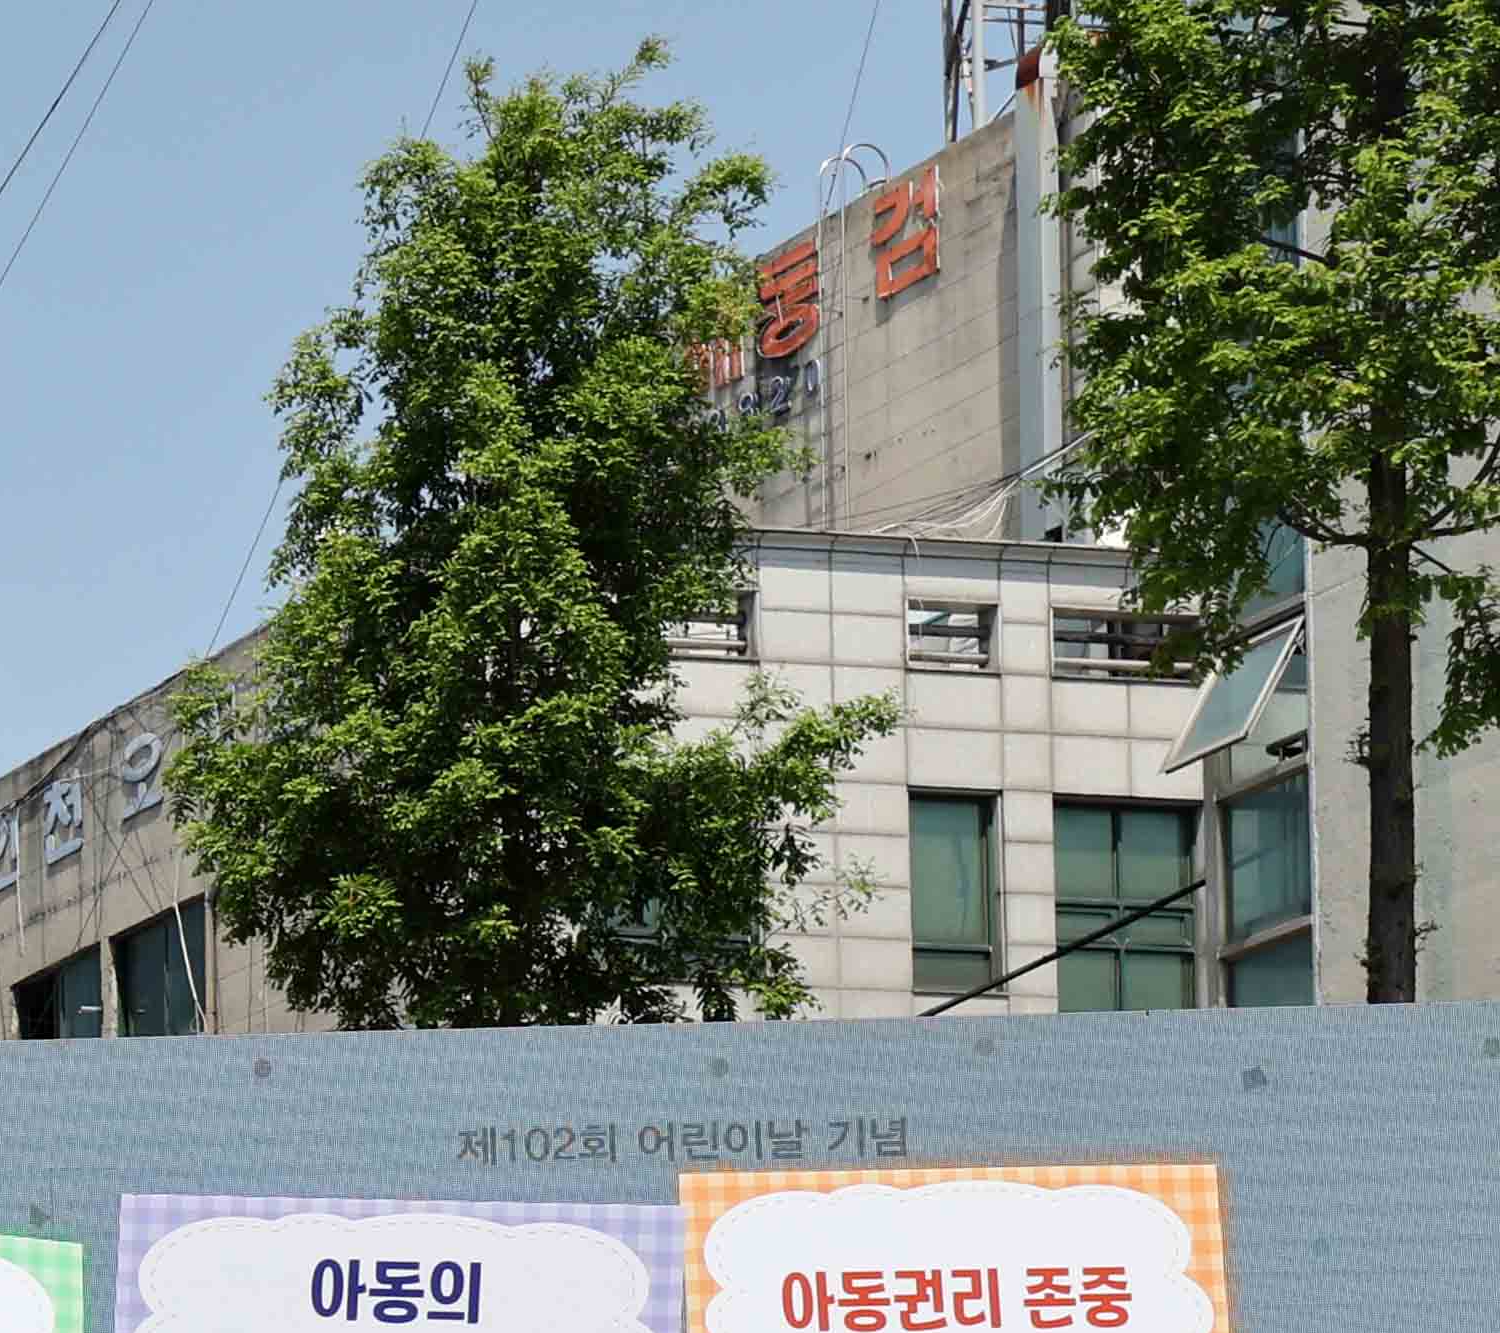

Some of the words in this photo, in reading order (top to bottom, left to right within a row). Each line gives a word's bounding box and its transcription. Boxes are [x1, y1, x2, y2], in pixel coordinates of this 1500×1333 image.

[457, 1124, 617, 1167] 제102회
[638, 1119, 807, 1160] 어린이날
[826, 1116, 908, 1158] 기념
[311, 1259, 481, 1324] 아동의
[782, 1268, 1001, 1332] 아동권리
[1024, 1267, 1132, 1329] 존중
